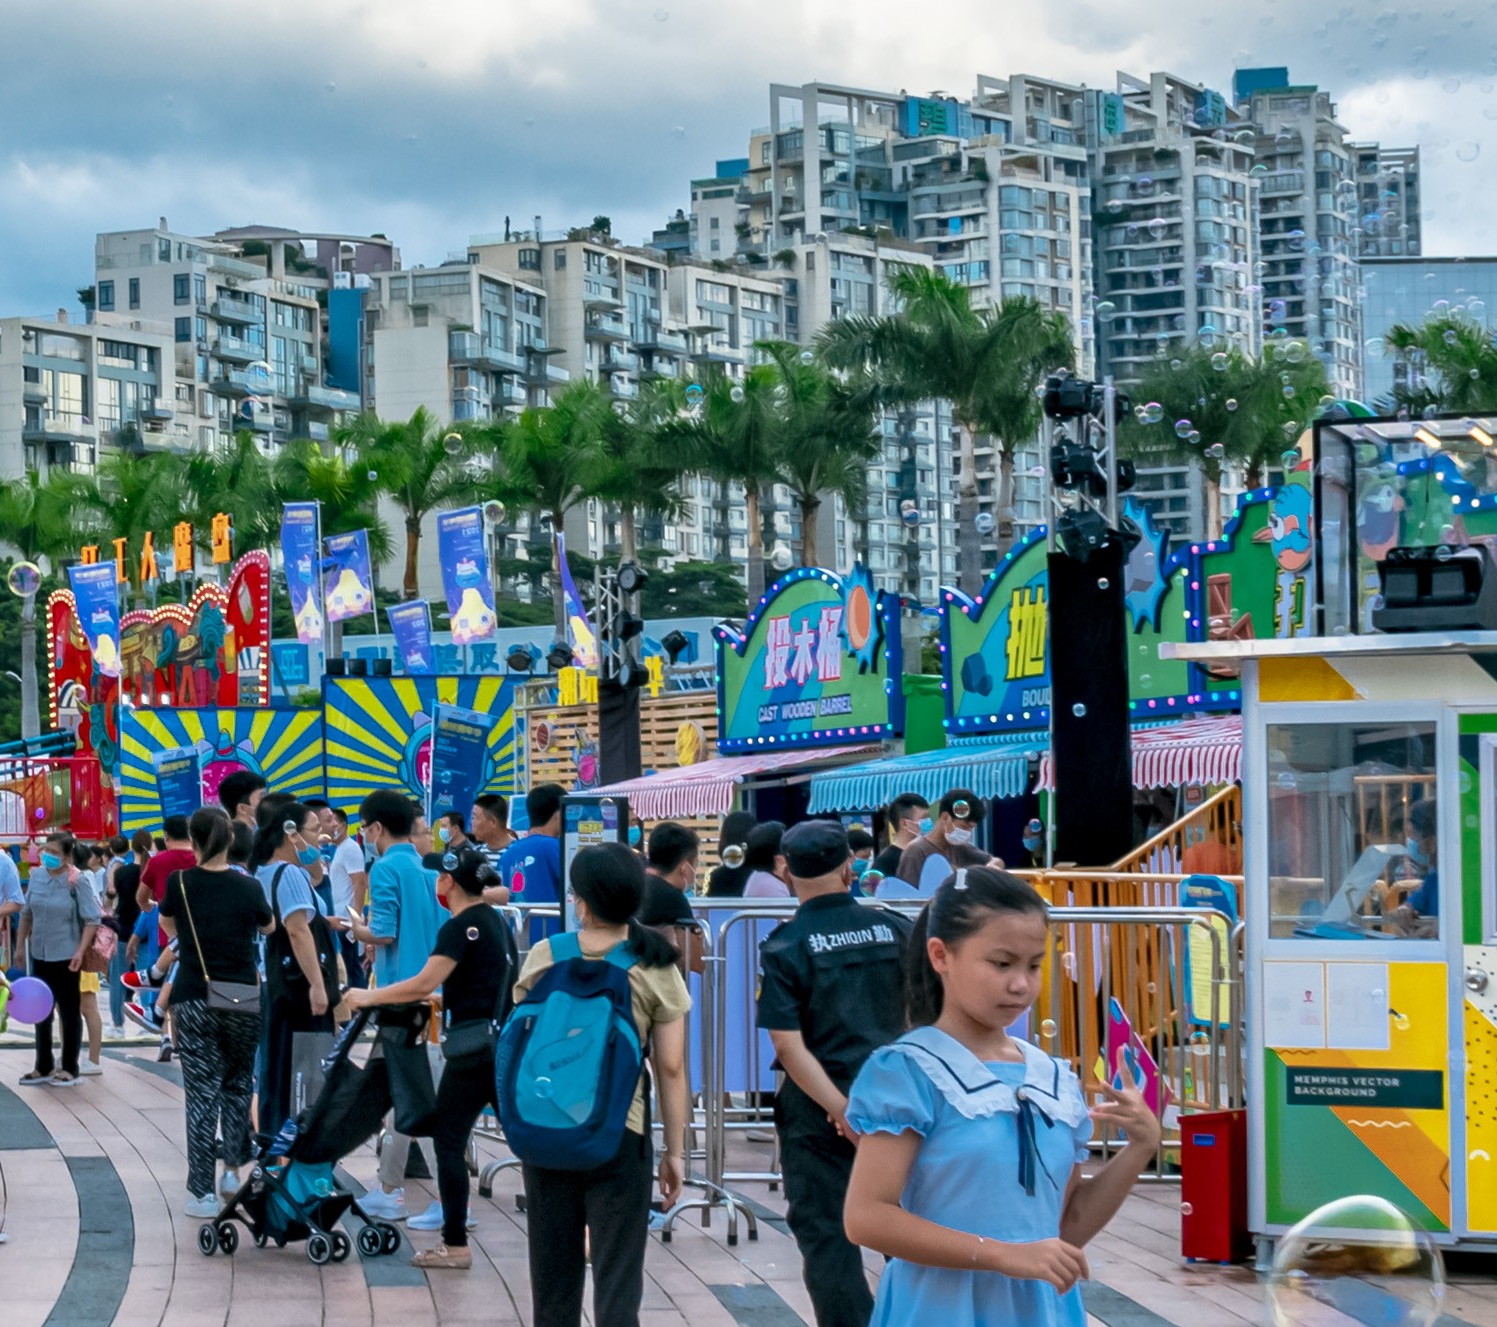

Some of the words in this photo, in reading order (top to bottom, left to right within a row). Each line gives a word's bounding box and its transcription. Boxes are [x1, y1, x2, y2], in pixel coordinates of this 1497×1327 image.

[758, 704, 779, 724] CAST
[781, 698, 818, 720] WOODEN
[819, 694, 852, 717] BARREL
[828, 929, 873, 947] ZHIQIN
[1294, 1075, 1349, 1086] MEMPHIS
[1353, 1076, 1401, 1088] VECTOR
[1294, 1085, 1377, 1098] BACKGROUND
